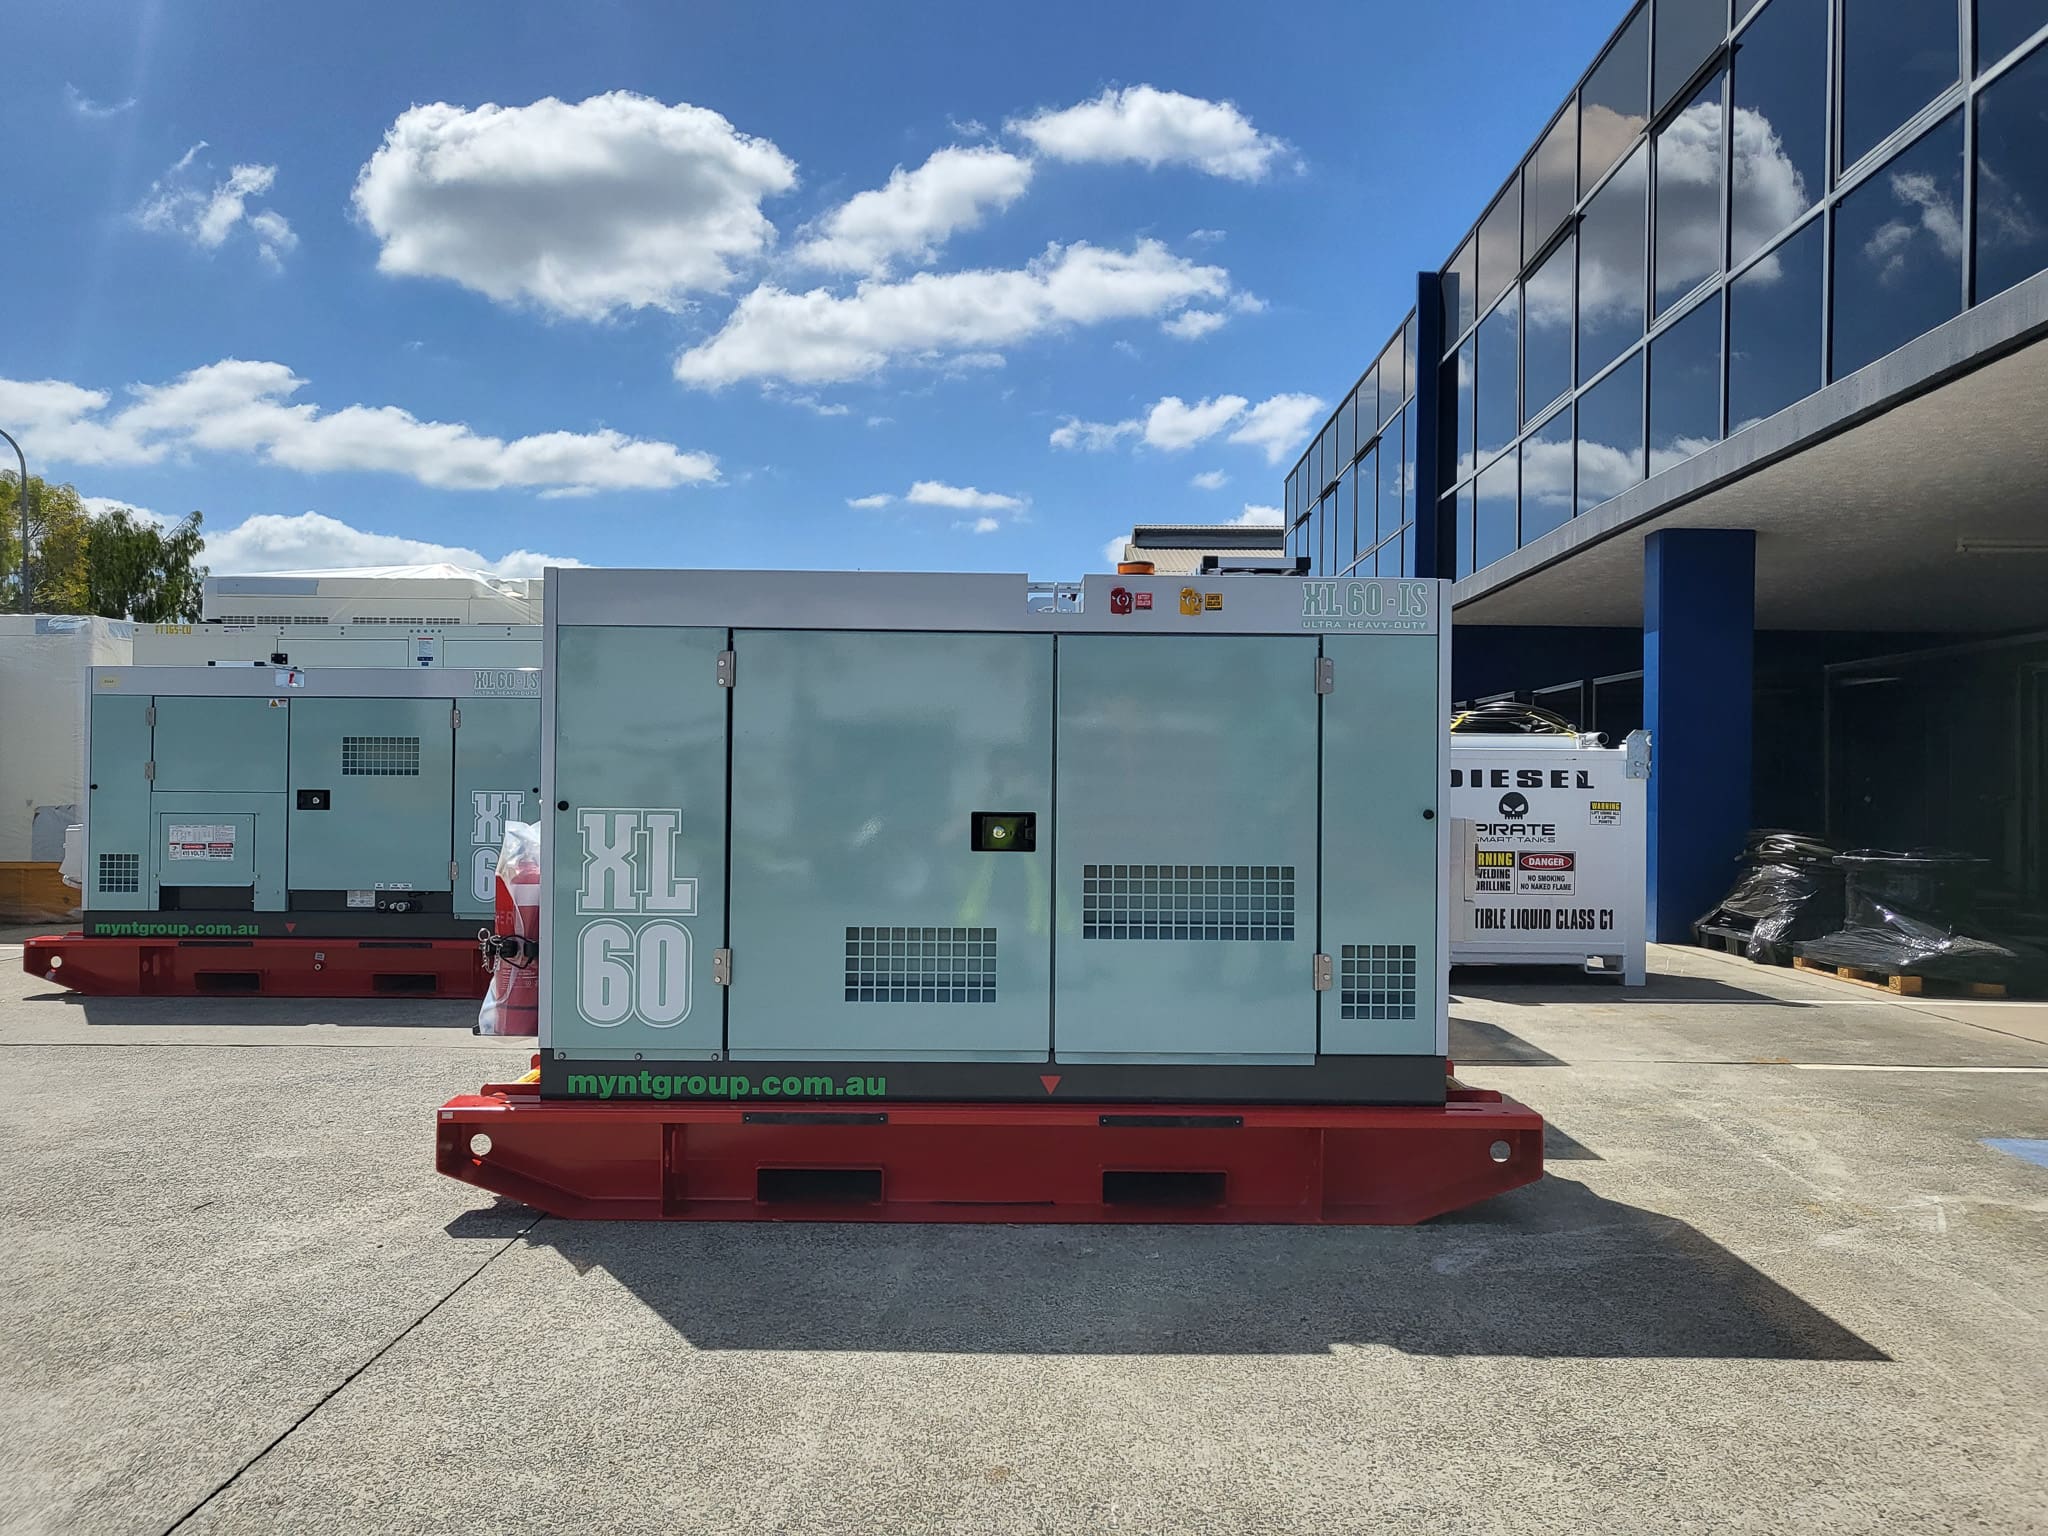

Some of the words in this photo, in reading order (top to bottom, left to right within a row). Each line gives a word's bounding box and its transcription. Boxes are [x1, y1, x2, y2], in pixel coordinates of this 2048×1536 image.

[1348, 621, 1426, 629] HEAVY-DUTY
[1591, 802, 1620, 810] WARNING
[1476, 824, 1556, 836] PIRATE
[576, 808, 698, 917] XL
[1528, 858, 1565, 867] DANGER
[1527, 874, 1537, 882] NO
[1537, 874, 1566, 882] SMOKING
[1530, 883, 1551, 891] NAKED
[1552, 883, 1572, 891] FLAME
[1510, 908, 1551, 930] LIQUID
[1555, 909, 1595, 930] CLASS
[1600, 909, 1614, 930] C1
[95, 921, 259, 937] myntgroup.com.au
[577, 918, 693, 1028] 60
[567, 1070, 888, 1100] myntgroup.com.au
